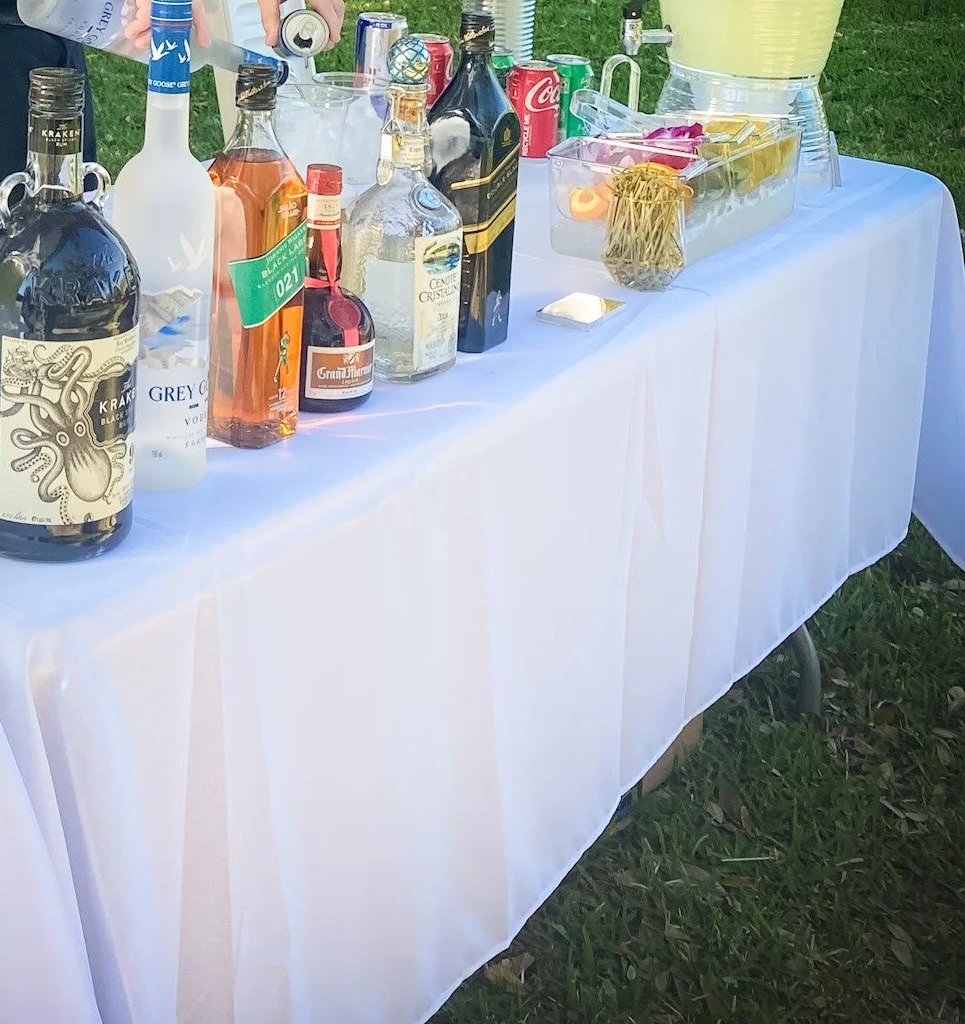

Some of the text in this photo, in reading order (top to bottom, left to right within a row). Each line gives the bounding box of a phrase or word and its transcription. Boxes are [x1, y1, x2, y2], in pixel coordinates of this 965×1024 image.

[96, 1, 114, 34] GREY
[41, 129, 80, 138] KRAKEN
[521, 113, 531, 157] RECYCLE ME
[261, 252, 288, 278] BLACK
[275, 265, 299, 298] 021
[429, 272, 457, 291] CENOTE
[148, 382, 196, 402] GREY
